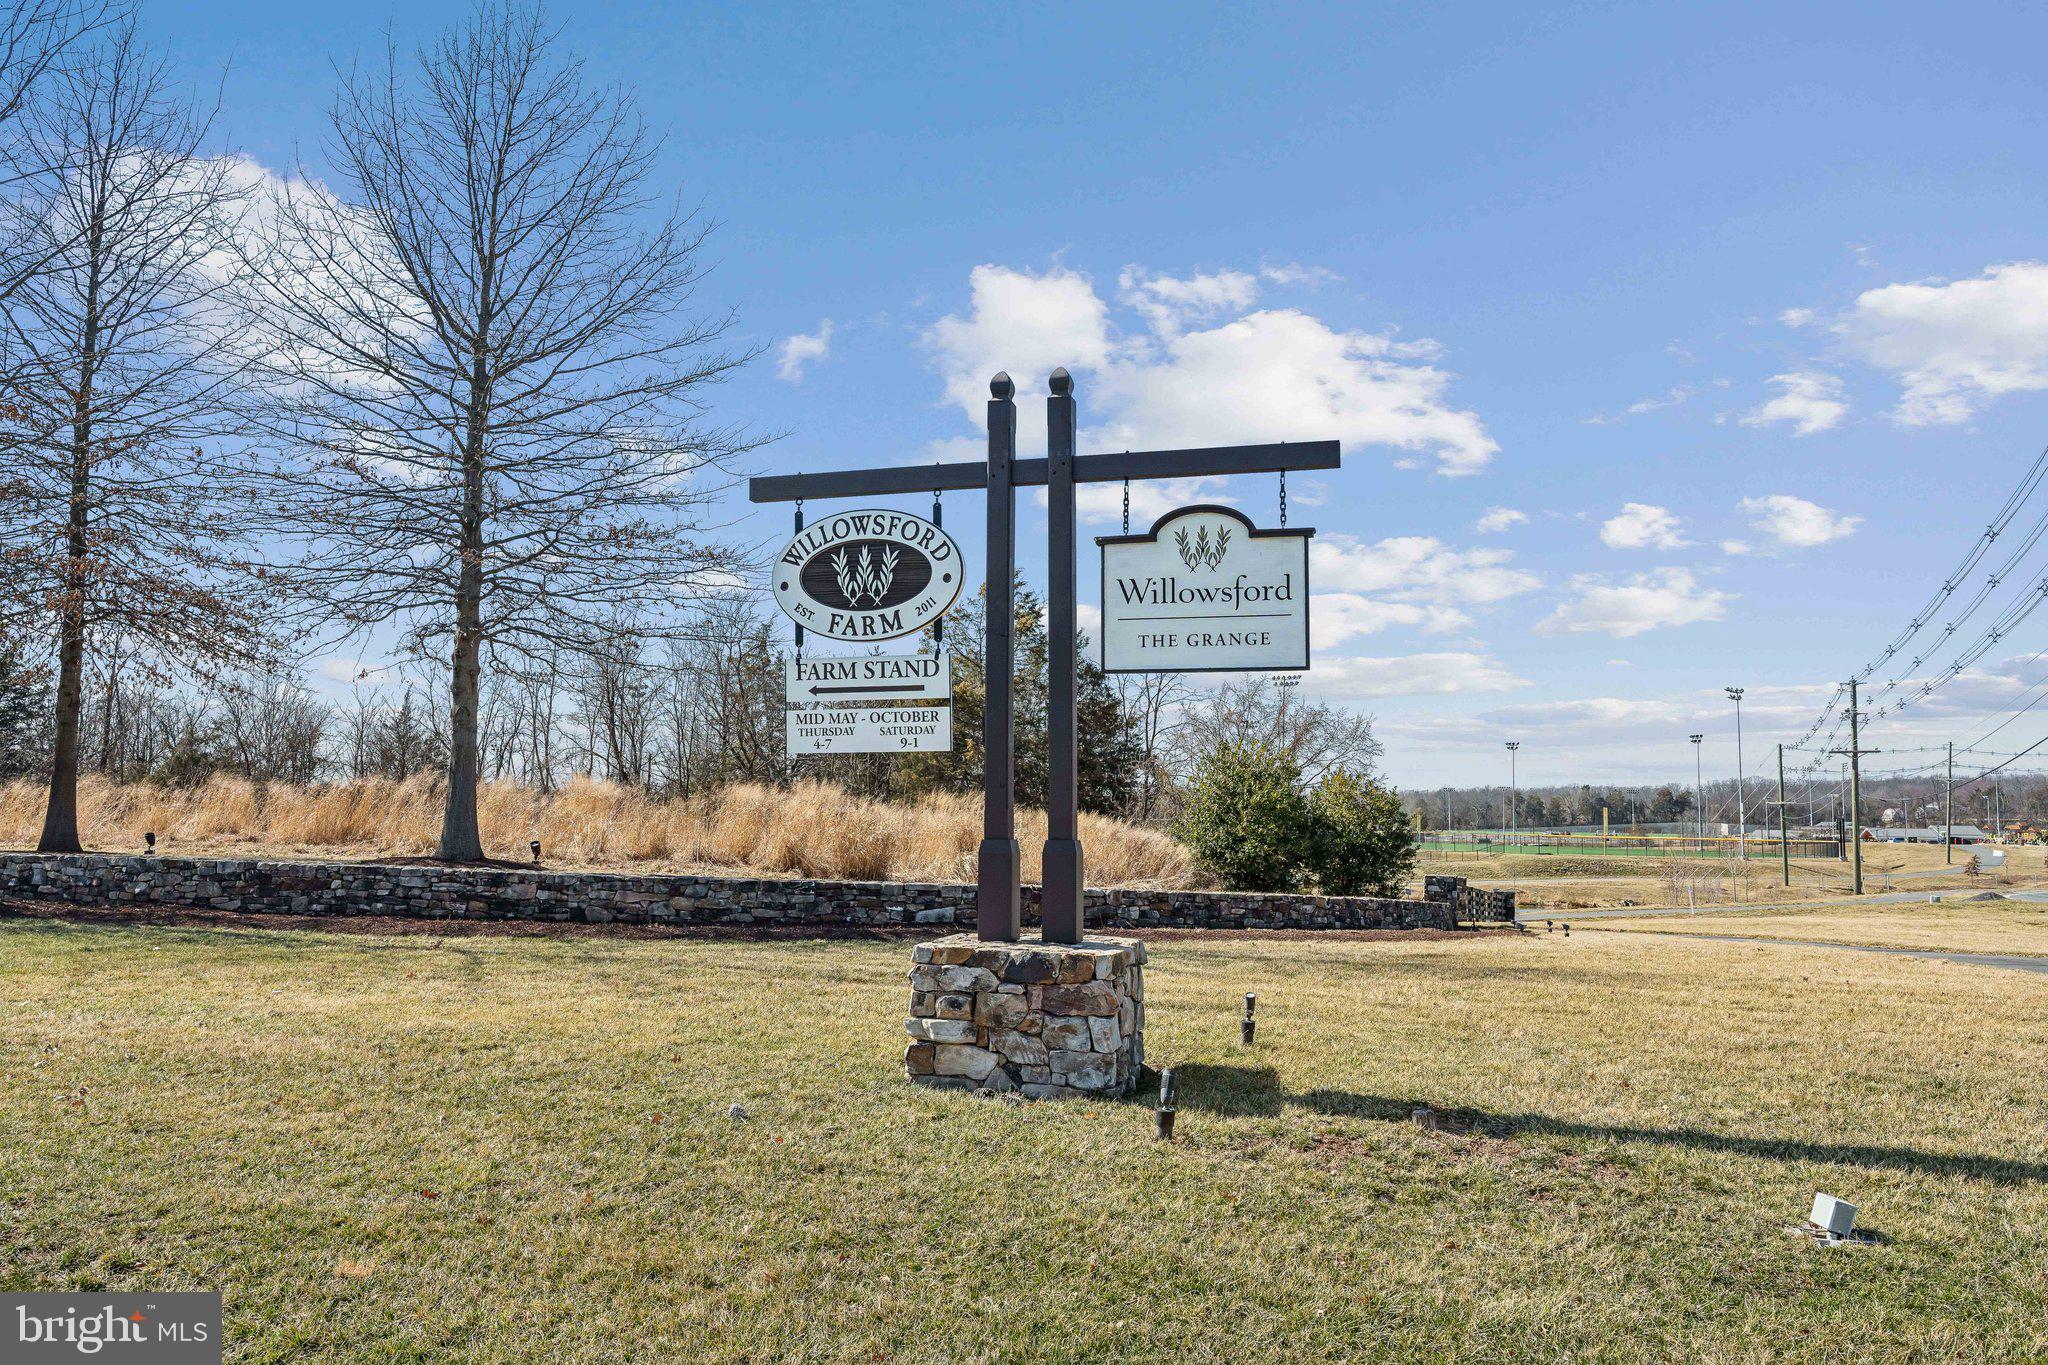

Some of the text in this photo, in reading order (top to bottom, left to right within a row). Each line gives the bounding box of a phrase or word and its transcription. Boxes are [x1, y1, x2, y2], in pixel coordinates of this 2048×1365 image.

[781, 514, 951, 567] WILLOWSFORD
[1117, 574, 1293, 611] Willowsford
[793, 602, 816, 622] EST.
[914, 596, 938, 617] 2011
[827, 609, 904, 636] FARM
[1137, 632, 1272, 648] THE GRANGE
[796, 659, 940, 681] FARM STAND
[796, 713, 825, 725] MID
[828, 712, 859, 724] MAY
[869, 710, 940, 724] OCTOBER
[797, 726, 856, 737] THURSDAY
[879, 725, 936, 736] SATURDAY
[813, 738, 833, 750] 4-7
[900, 737, 919, 749] 9-1
